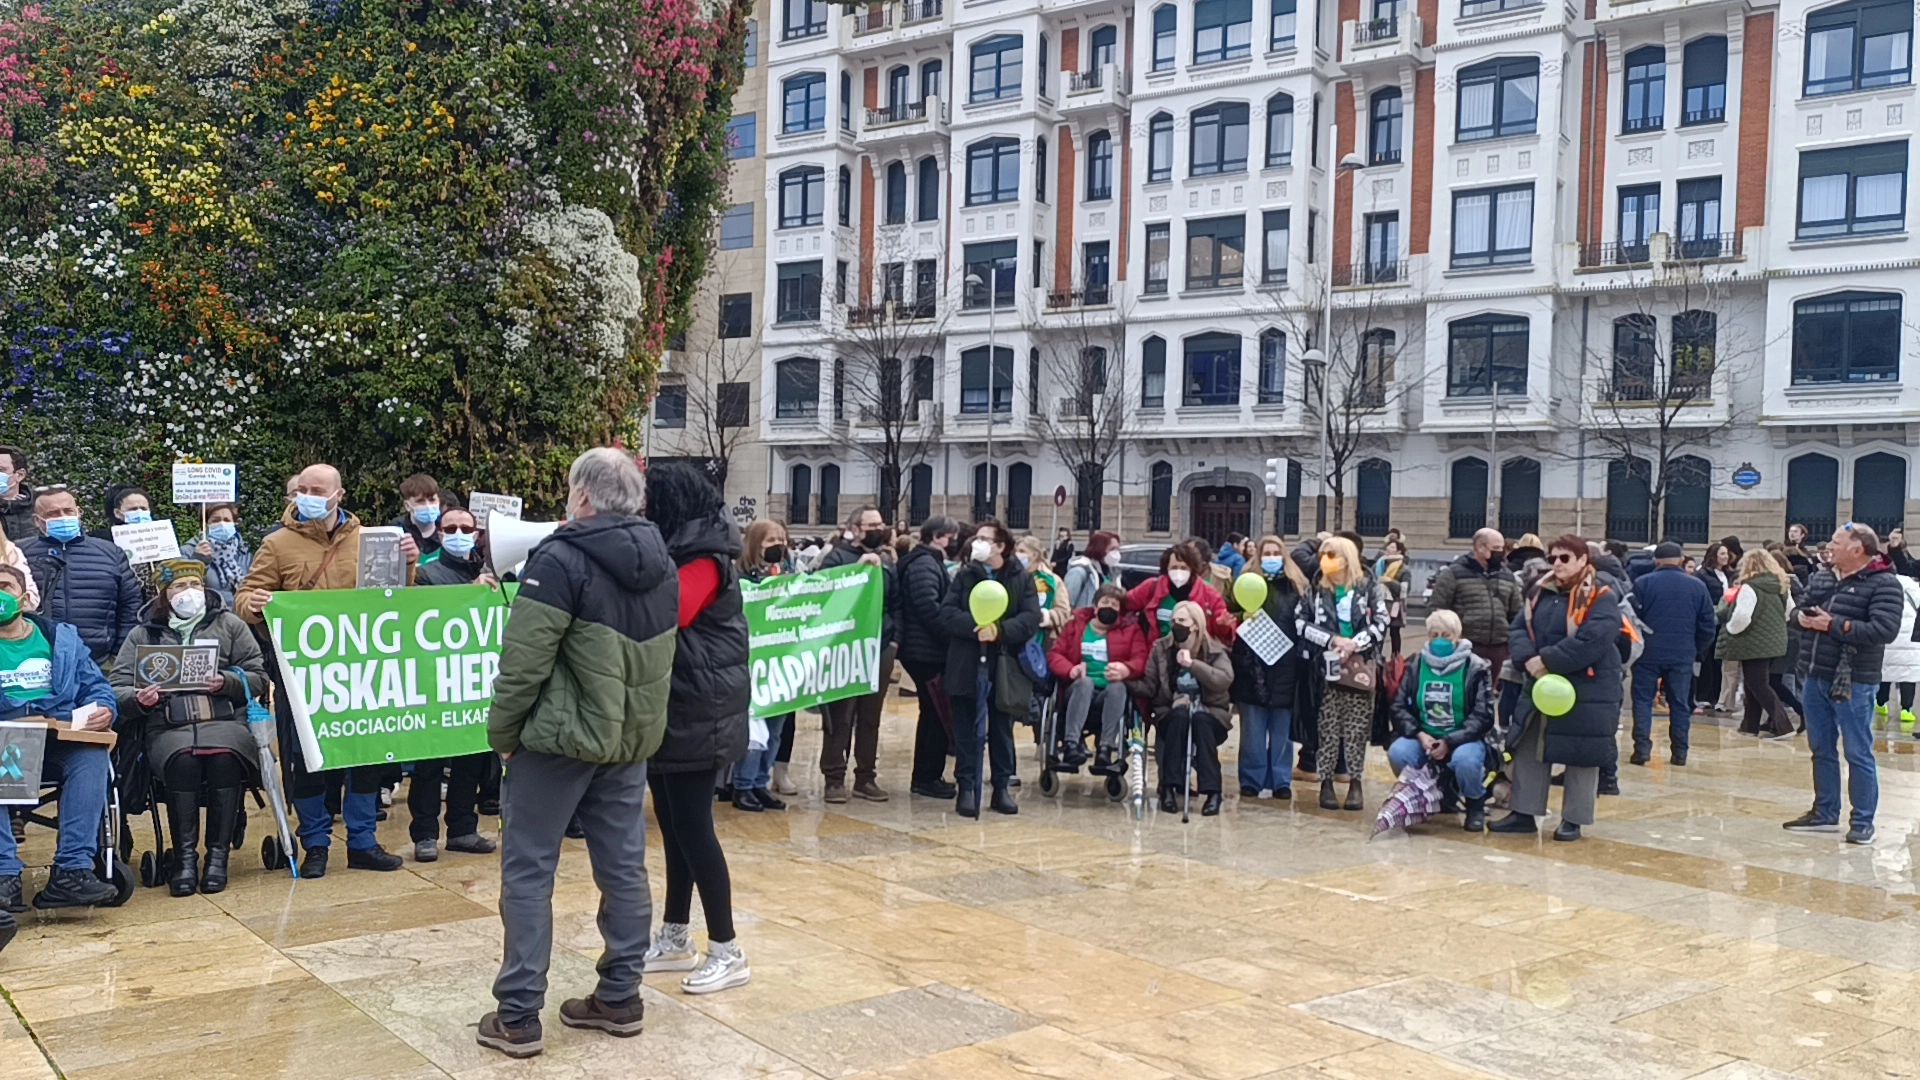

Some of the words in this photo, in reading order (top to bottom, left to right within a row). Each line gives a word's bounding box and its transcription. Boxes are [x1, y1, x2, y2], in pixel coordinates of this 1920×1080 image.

[272, 611, 402, 660] LONG
[414, 606, 507, 651] CoVI
[436, 651, 501, 704] HER
[750, 637, 880, 707] CAPACIDAD
[318, 710, 427, 740] ASOCIACIÓN
